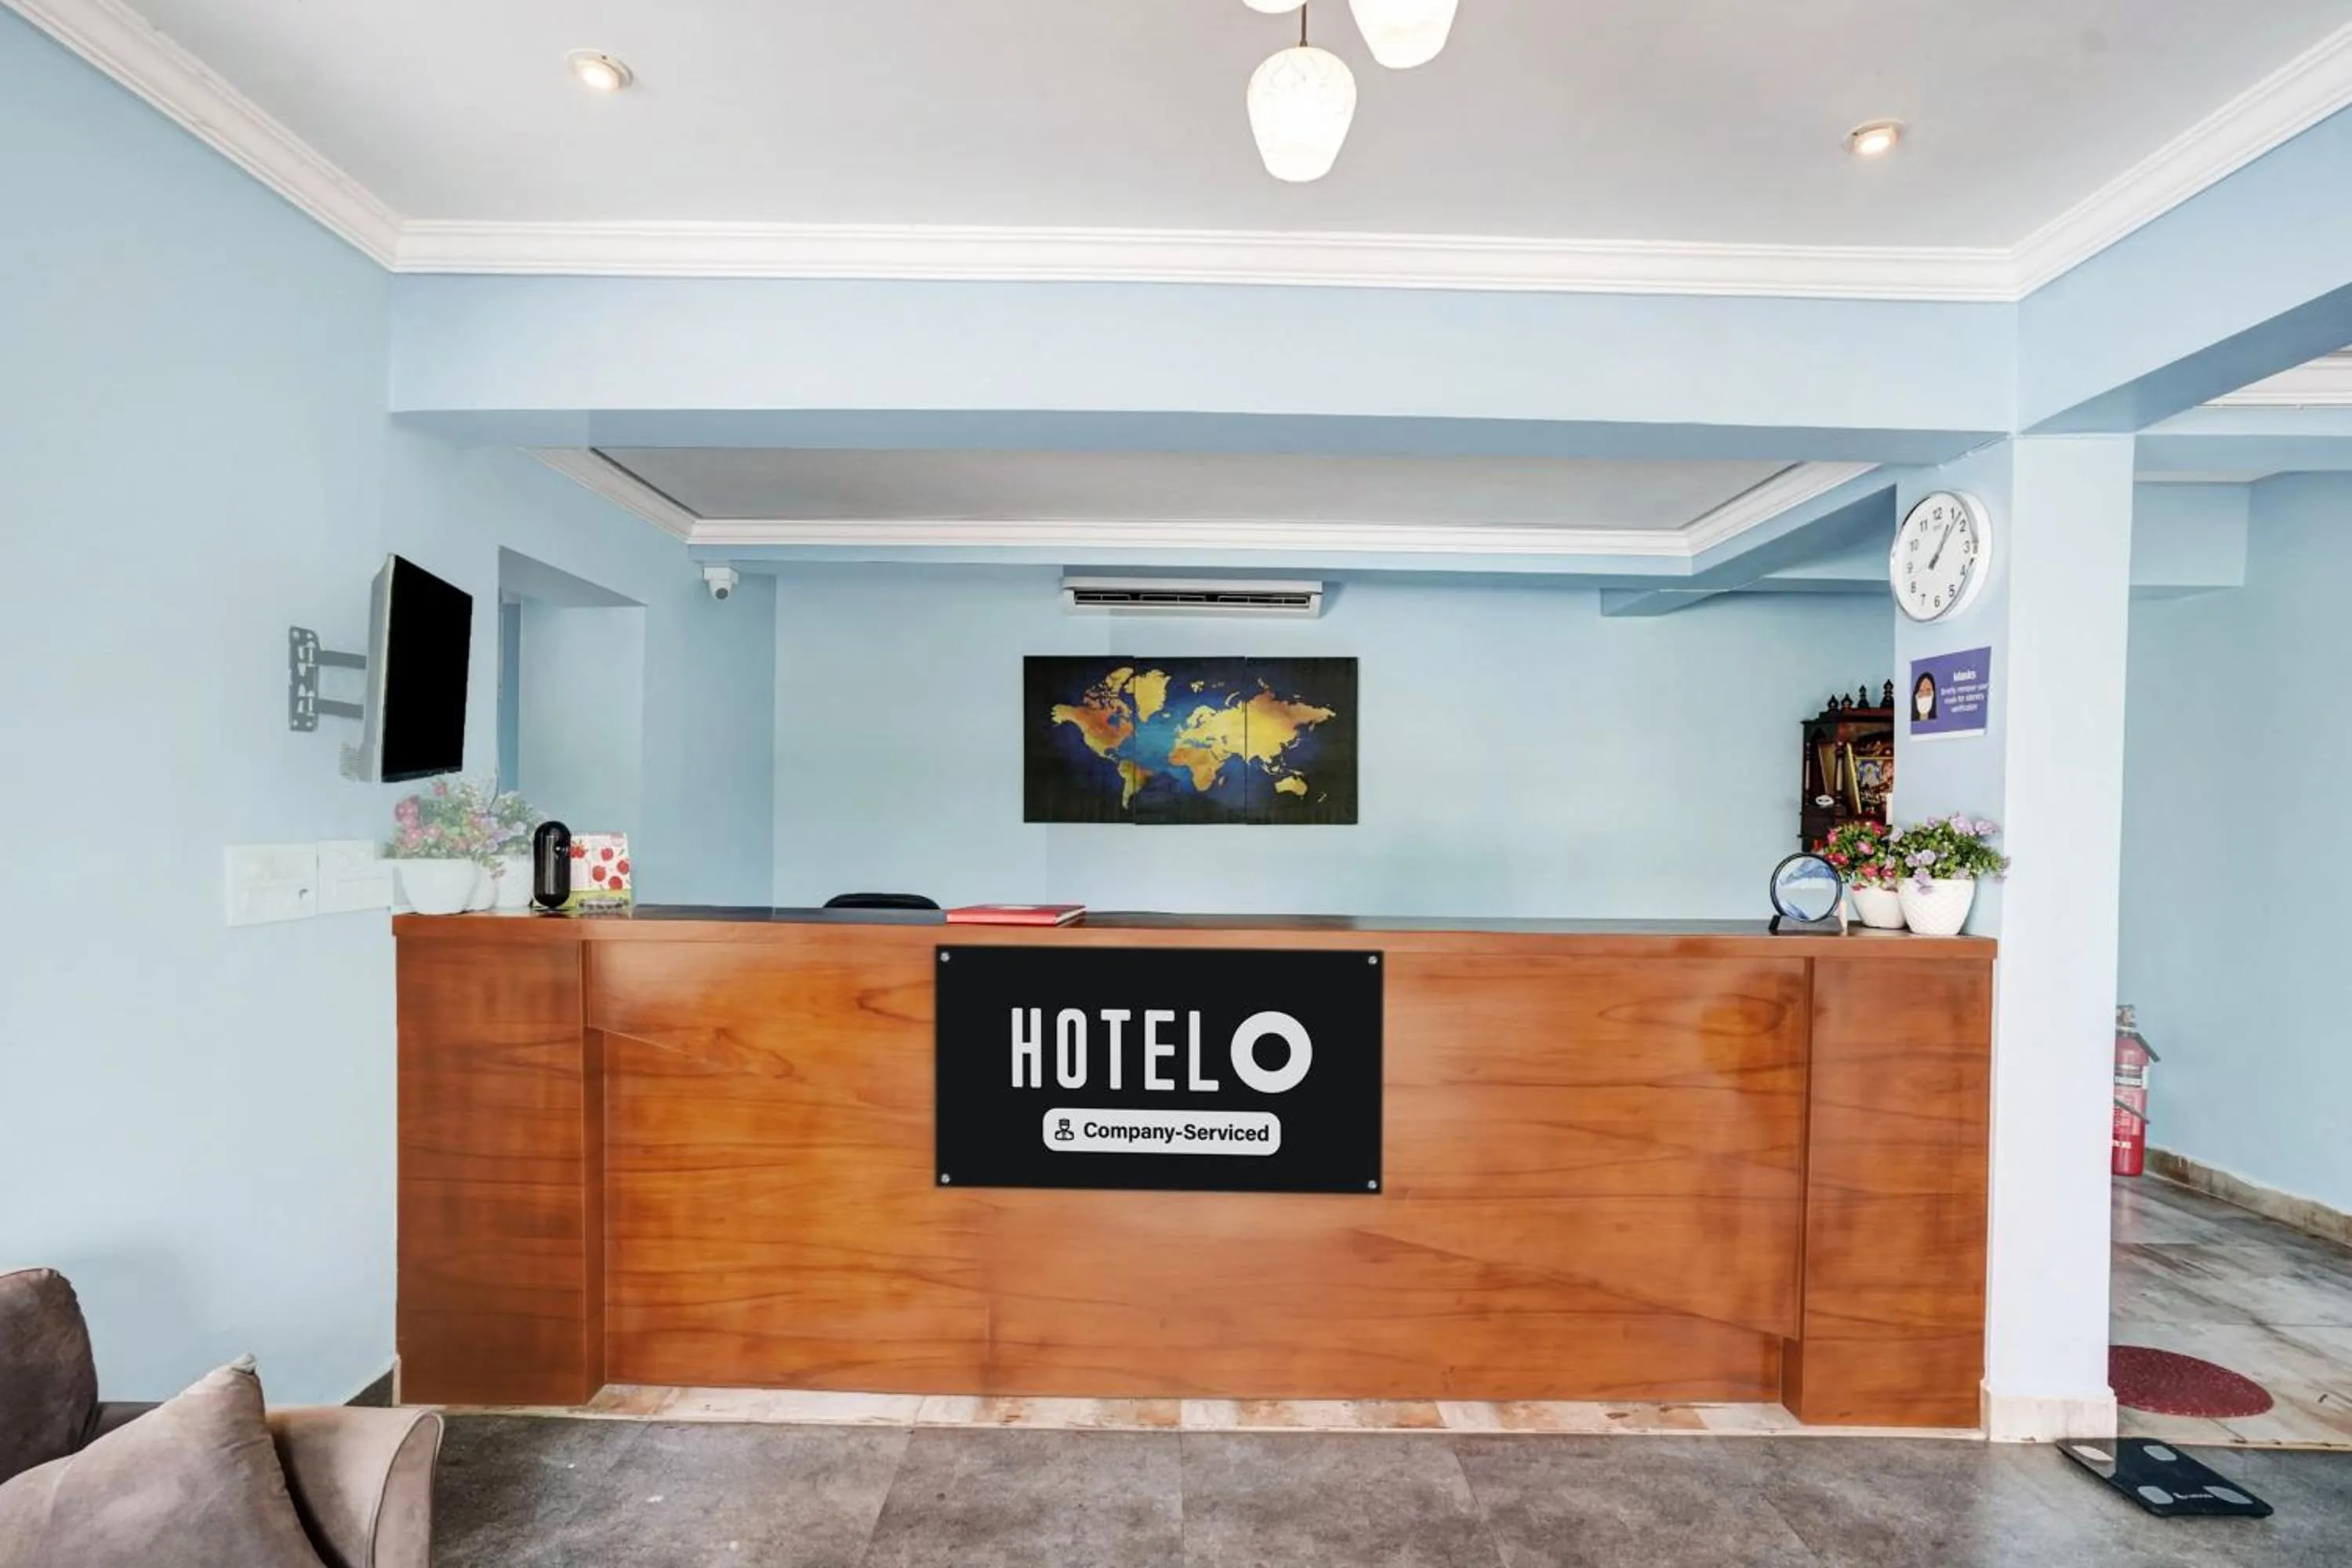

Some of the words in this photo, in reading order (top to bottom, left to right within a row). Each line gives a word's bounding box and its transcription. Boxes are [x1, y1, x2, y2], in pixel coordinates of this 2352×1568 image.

[1933, 506, 1943, 521] 12
[1950, 507, 1955, 520] 1
[1919, 519, 1928, 533] 11
[1959, 519, 1967, 532] 2
[1909, 539, 1919, 553] 10
[1963, 540, 1970, 554] 3
[1906, 561, 1914, 575] 9
[1910, 581, 1917, 593] 8
[1948, 584, 1955, 598] 5
[1920, 593, 1926, 607] 7
[1933, 595, 1941, 608] 6
[1083, 1122, 1270, 1144] Company-Serviced
